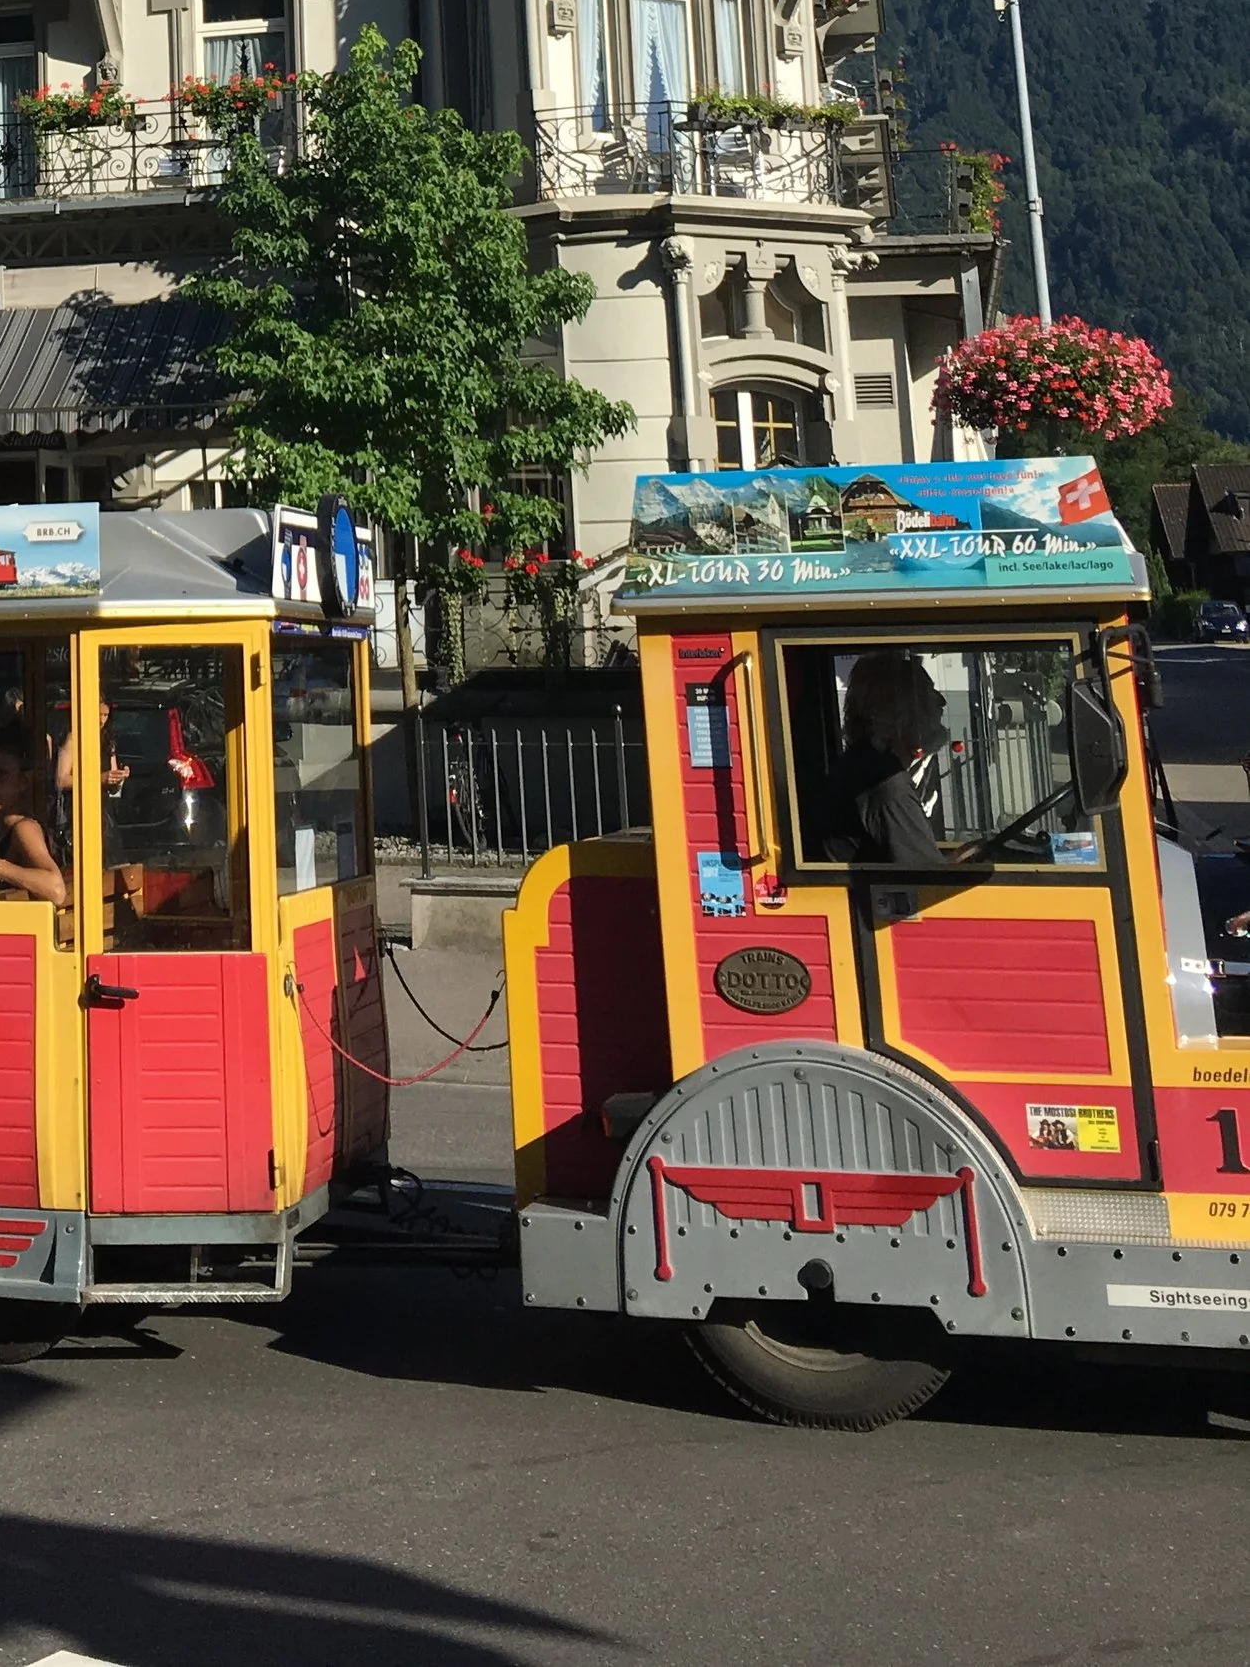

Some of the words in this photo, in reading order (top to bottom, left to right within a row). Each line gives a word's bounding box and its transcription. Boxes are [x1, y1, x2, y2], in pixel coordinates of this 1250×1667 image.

[37, 527, 71, 537] BRB.CH
[1012, 536, 1036, 555] 60
[757, 559, 784, 582] 30
[999, 562, 1020, 572] incl.
[1023, 560, 1114, 573] See/lake/lac/lago
[741, 952, 784, 965] TRAINS
[727, 971, 799, 990] DOTTO
[1193, 1067, 1250, 1082] boedel
[1209, 1202, 1236, 1217] 079
[1150, 1290, 1250, 1309] Sightseeing
